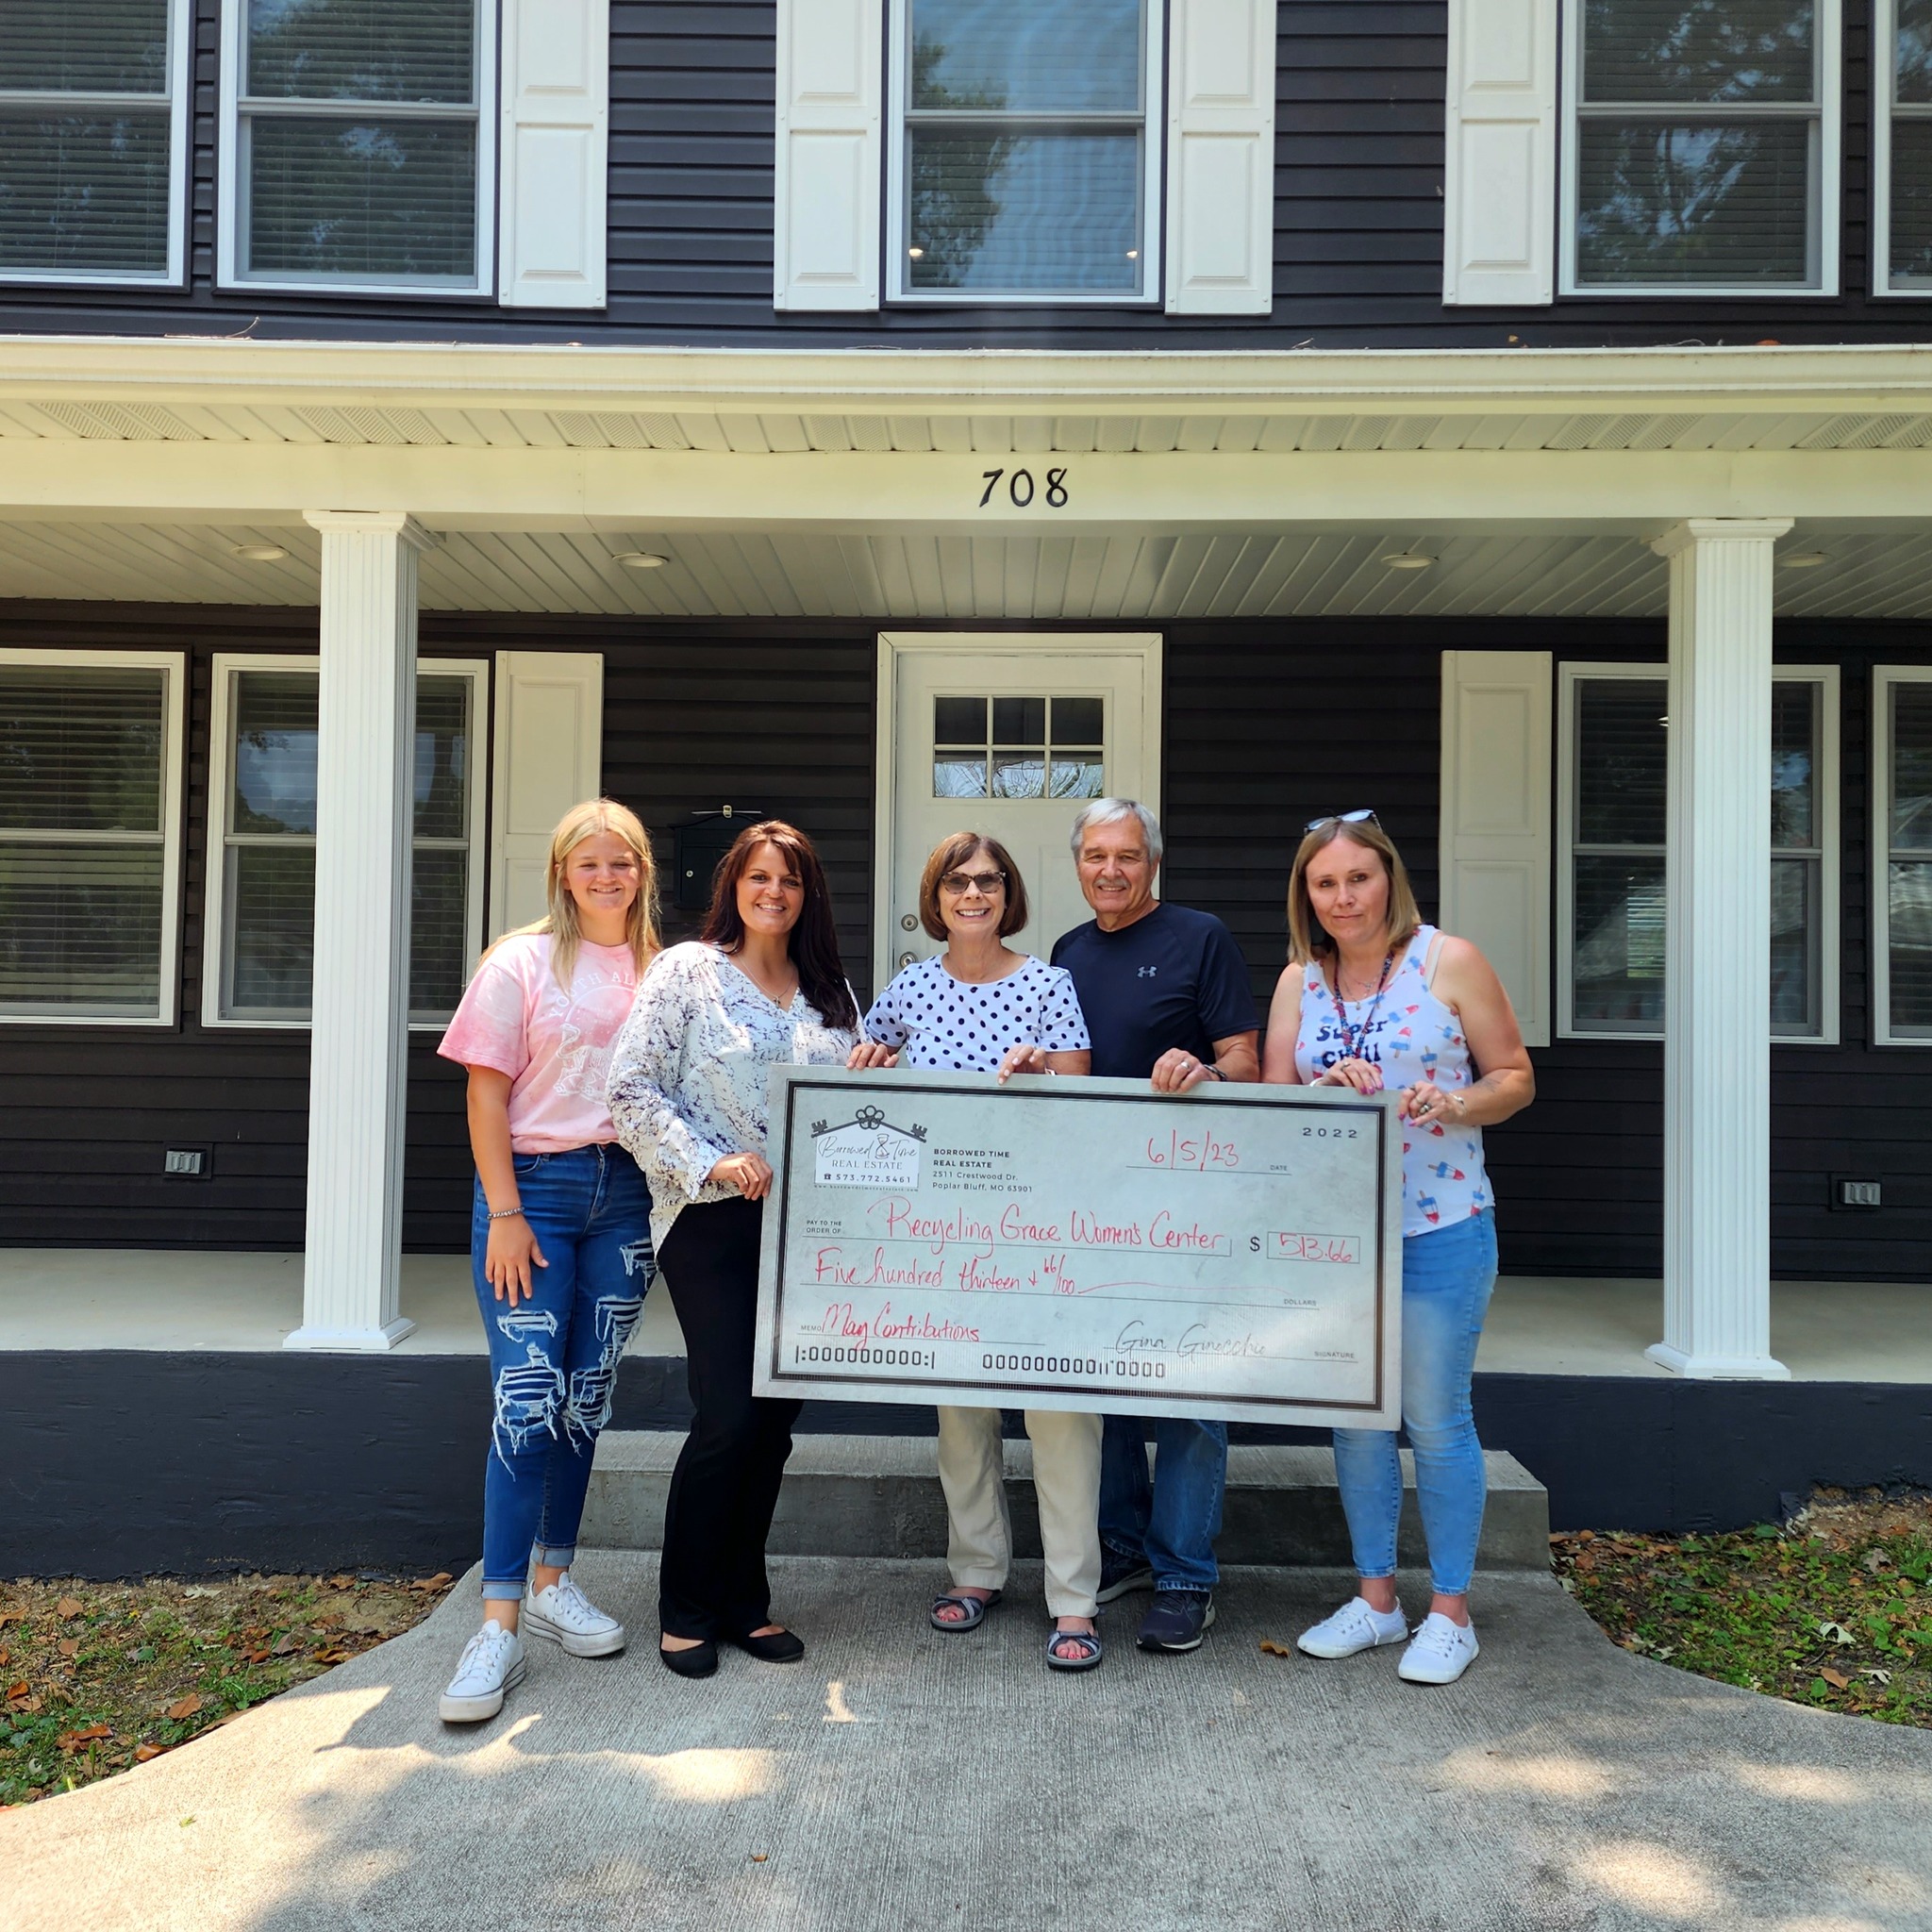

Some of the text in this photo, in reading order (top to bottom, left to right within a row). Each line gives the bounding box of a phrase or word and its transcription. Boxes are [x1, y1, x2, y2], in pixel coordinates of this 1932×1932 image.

[979, 468, 1068, 508] 708
[1303, 1127, 1357, 1139] 2022
[818, 1136, 917, 1159] Borrowed Time
[934, 1149, 986, 1158] BORROWED
[1147, 1129, 1239, 1172] 6/5/23
[832, 1159, 903, 1170] REAL ESTATE
[836, 1174, 910, 1183] 573.772.5461
[957, 1172, 1002, 1180] Crestwood
[963, 1183, 987, 1191] Bluff,
[867, 1195, 1224, 1259] Recycling Grace Women's Center
[1249, 1236, 1260, 1252] $
[1279, 1232, 1352, 1262] 513.66
[816, 1247, 860, 1285] Five
[864, 1246, 944, 1288] hundred
[958, 1258, 1020, 1291] thirteen
[822, 1302, 980, 1351] May Contributions
[1314, 1351, 1354, 1359] SIGNATURE
